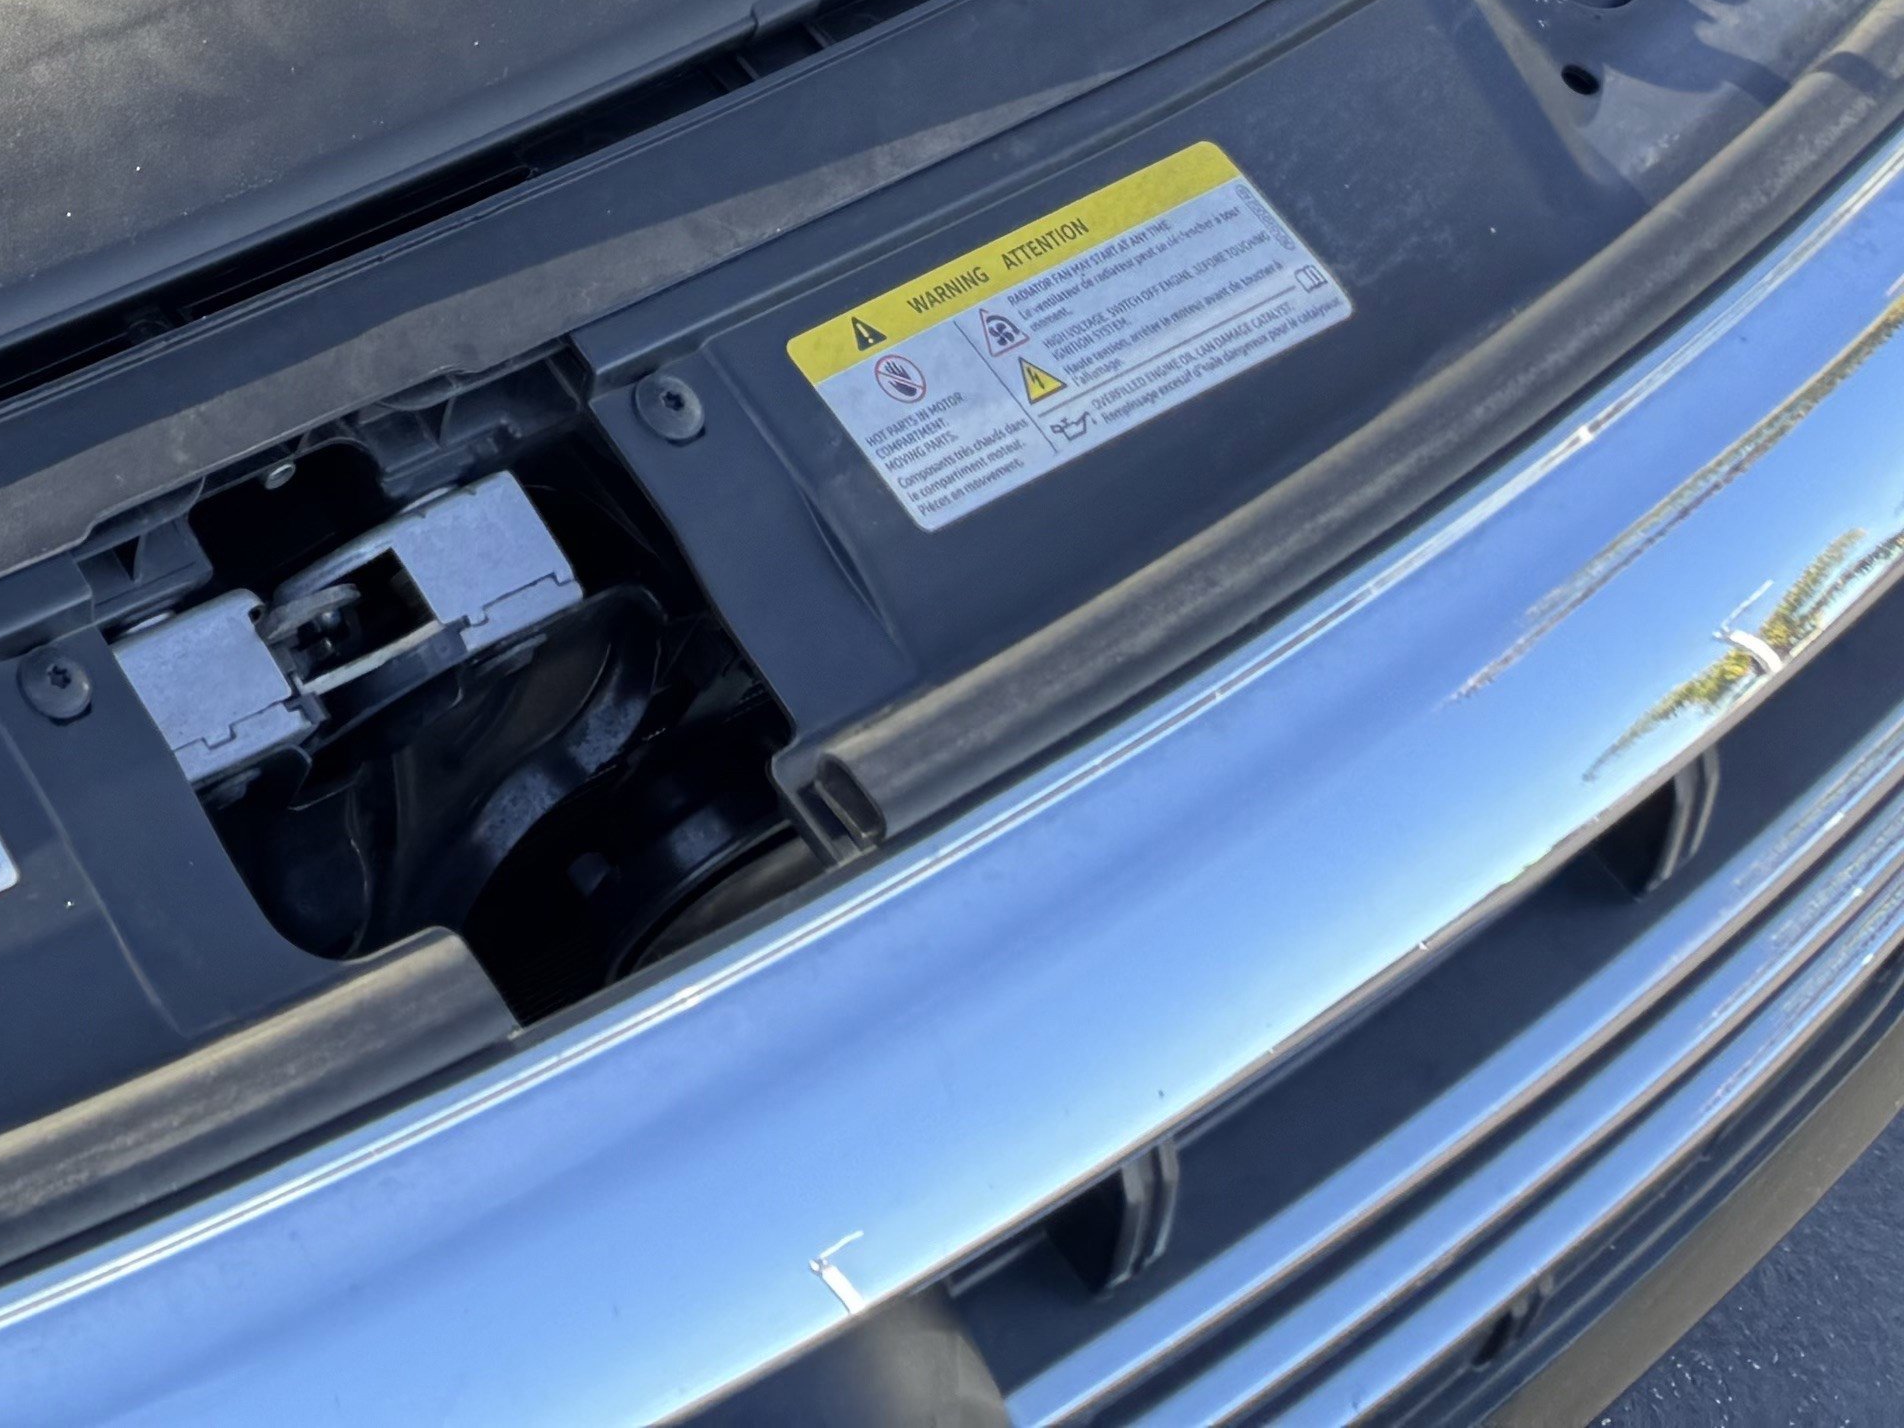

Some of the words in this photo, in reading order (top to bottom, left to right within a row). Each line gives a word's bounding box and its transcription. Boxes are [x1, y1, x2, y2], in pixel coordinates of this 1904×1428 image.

[906, 264, 991, 316] WARNING
[997, 216, 1090, 271] ATTENTION
[864, 428, 890, 448] HOT
[884, 414, 919, 437] PARTS
[914, 408, 931, 422] IN
[926, 391, 965, 416] MOTOR
[883, 445, 927, 473] MOVING
